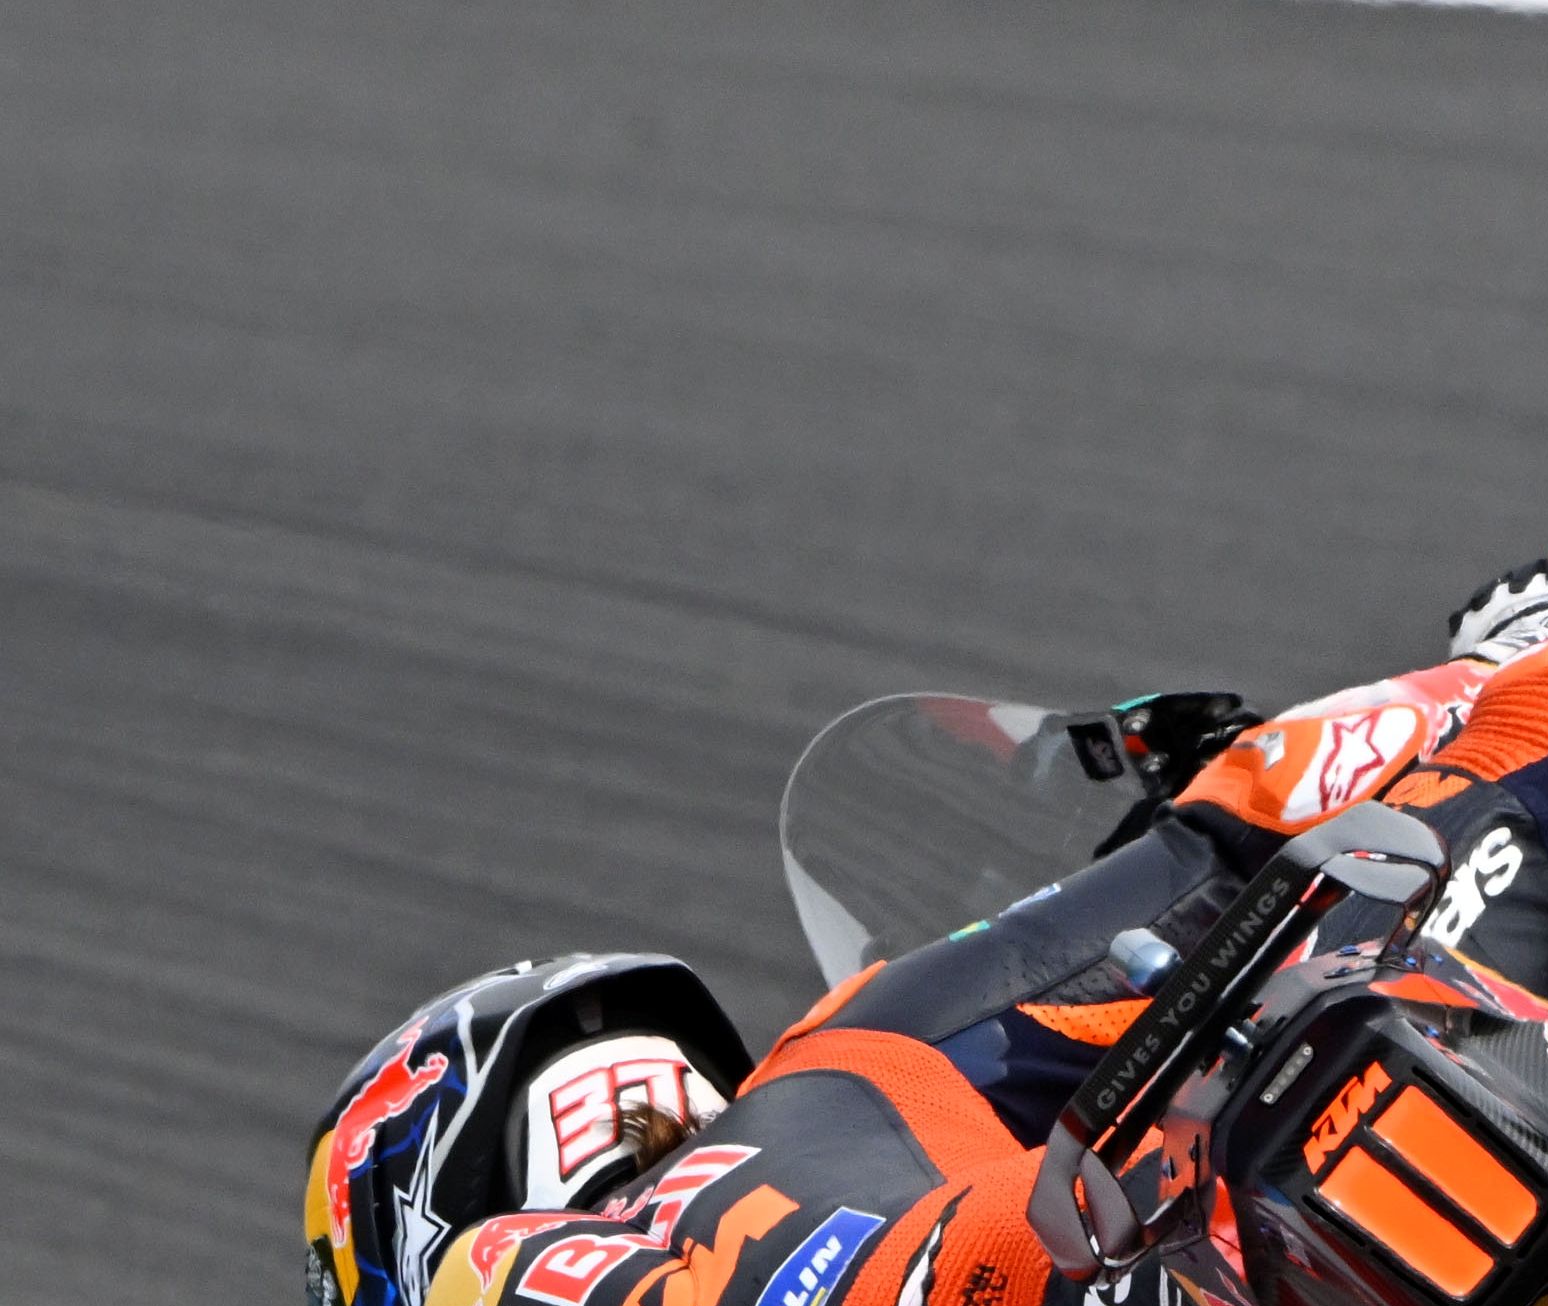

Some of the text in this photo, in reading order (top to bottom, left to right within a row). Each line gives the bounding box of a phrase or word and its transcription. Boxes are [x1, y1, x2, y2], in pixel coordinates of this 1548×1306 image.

[1096, 877, 1291, 1110] GIVES YOU WINGS
[1303, 1060, 1392, 1176] KTM
